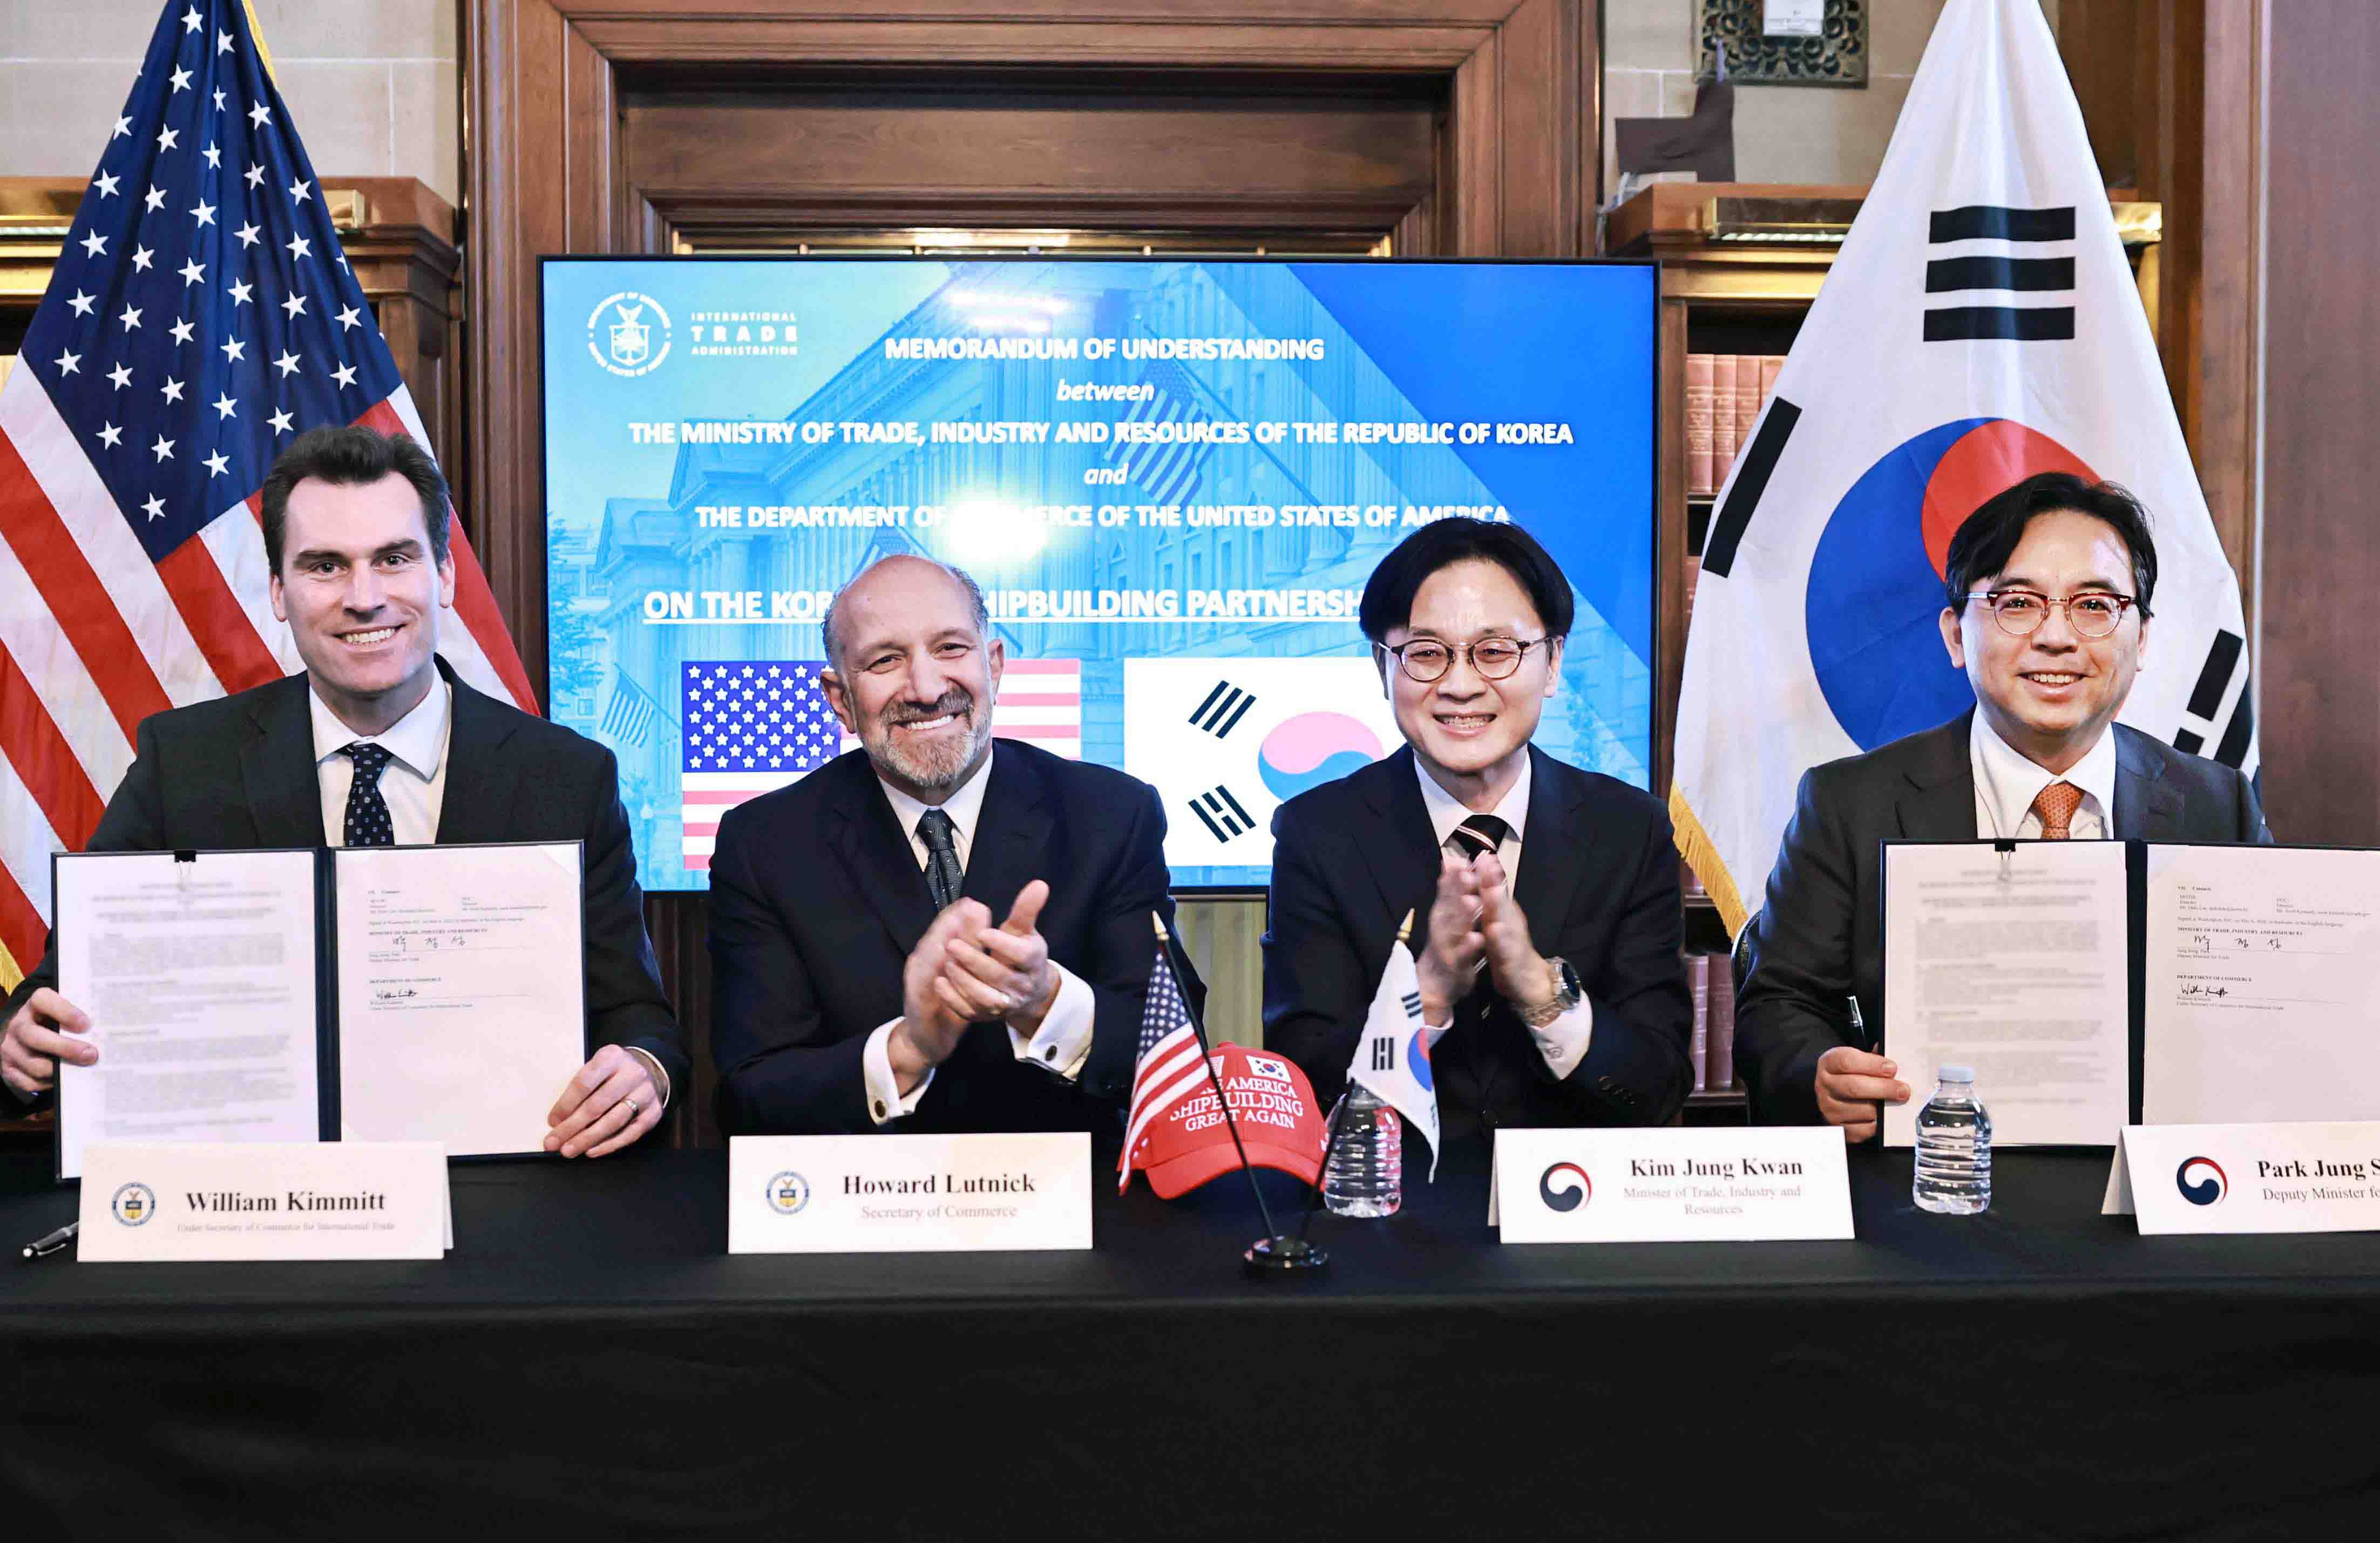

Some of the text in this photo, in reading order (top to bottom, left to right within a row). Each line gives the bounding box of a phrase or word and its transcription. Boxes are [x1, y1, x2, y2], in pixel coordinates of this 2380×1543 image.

[691, 312, 796, 322] INTERNATIONAL
[691, 326, 798, 342] TRADE
[691, 346, 798, 355] ADMINISTRATION
[886, 338, 1324, 360] MEMORANDUM OF UNDERSTANDING
[1056, 380, 1154, 401] between
[629, 422, 1573, 446] THE MINISTRY OF TRADE, INDUSTRY AND RESOURCES OF THE REPUBLIC OF KOREA
[1084, 463, 1129, 484] and
[696, 506, 741, 527] THE
[748, 506, 910, 527] DEPARTMENT
[914, 506, 946, 527] OF
[1099, 506, 1130, 526] OF
[1135, 506, 1181, 526] THE
[1187, 506, 1274, 527] UNITED
[1281, 506, 1359, 526] STATES
[1365, 506, 1396, 527] OF
[645, 591, 693, 618] ON
[701, 591, 762, 618] THE
[984, 590, 1179, 618] HIPBUILDING
[1188, 590, 1364, 617] PARTNERSH
[1226, 1077, 1298, 1098] AMERICA
[1185, 1109, 1295, 1132] GREAT AGAIN
[1631, 1158, 1803, 1181] Kim Jung Kwan
[2256, 1160, 2309, 1178] Park
[2314, 1158, 2367, 1181] Jung
[843, 1173, 1036, 1195] Howard Lutnick
[1623, 1187, 1671, 1198] Minister
[1675, 1186, 1690, 1197] of
[1730, 1185, 1775, 1200] Industry
[1780, 1185, 1801, 1197] and
[186, 1190, 387, 1212] William Kimmitt
[2263, 1188, 2308, 1204] Deputy
[2312, 1186, 2364, 1199] Minister
[862, 1204, 1017, 1222] Secretary of Commerce
[1684, 1203, 1744, 1215] Resources
[177, 1223, 203, 1233] Under
[206, 1223, 242, 1233] Secretary
[256, 1223, 300, 1231] Commerce
[317, 1222, 368, 1231] International
[372, 1222, 396, 1231] Trade
